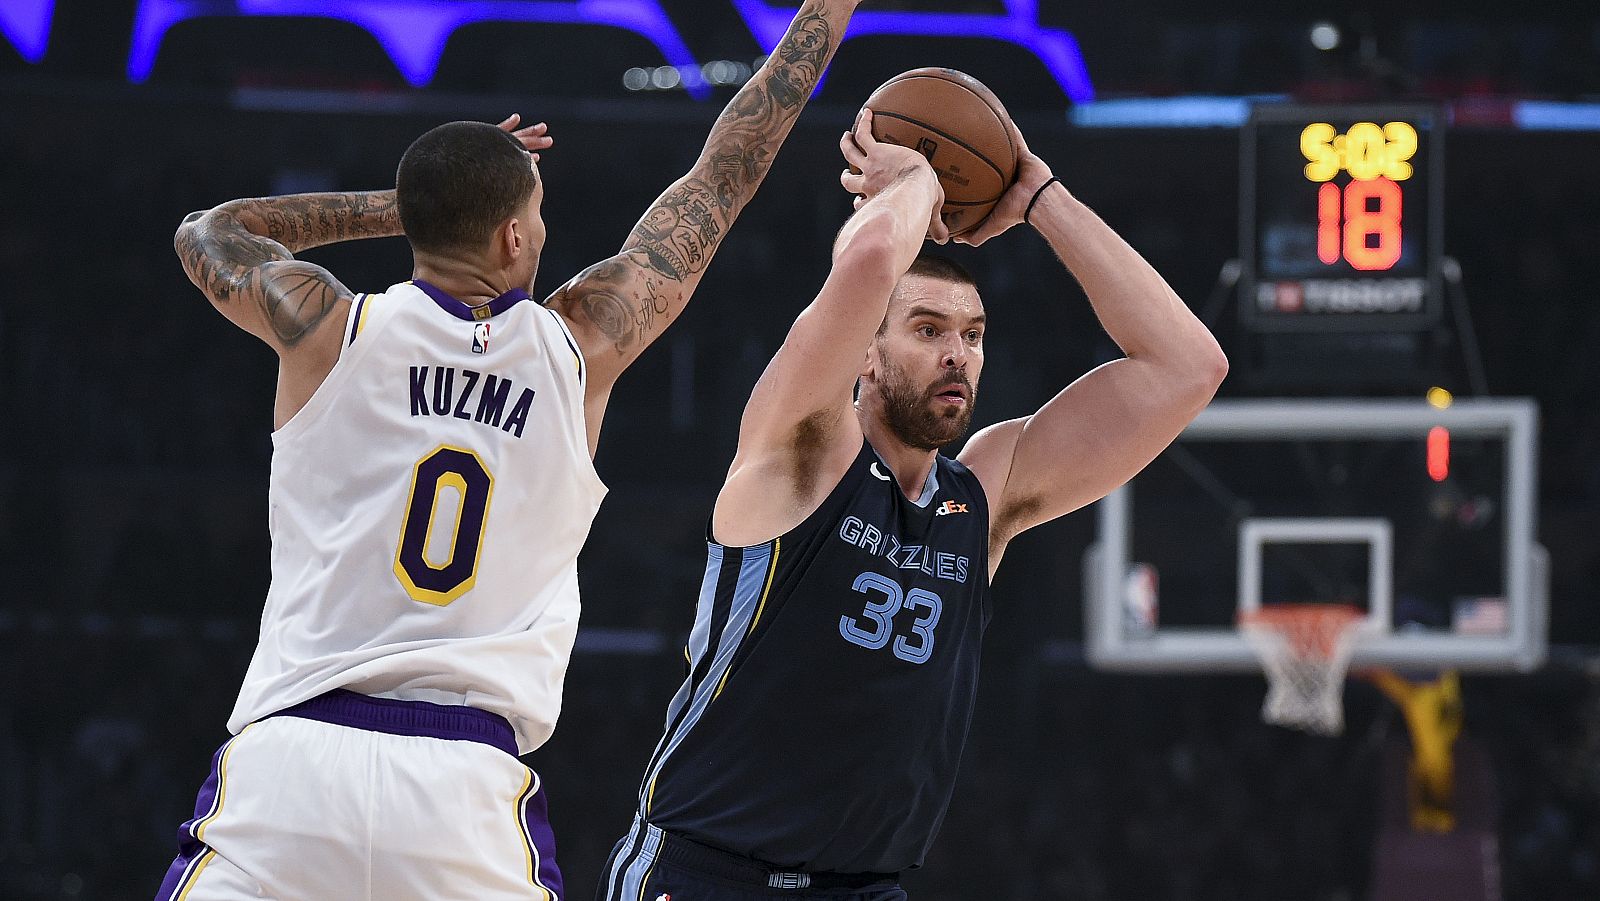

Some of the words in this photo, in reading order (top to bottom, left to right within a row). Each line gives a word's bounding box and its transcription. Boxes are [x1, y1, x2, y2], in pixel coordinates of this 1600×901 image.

[1300, 122, 1418, 182] 5:02
[1317, 177, 1403, 270] 18
[409, 366, 535, 438] KUZMA
[393, 443, 495, 607] 0
[936, 500, 968, 516] dEx
[839, 571, 943, 664] 33
